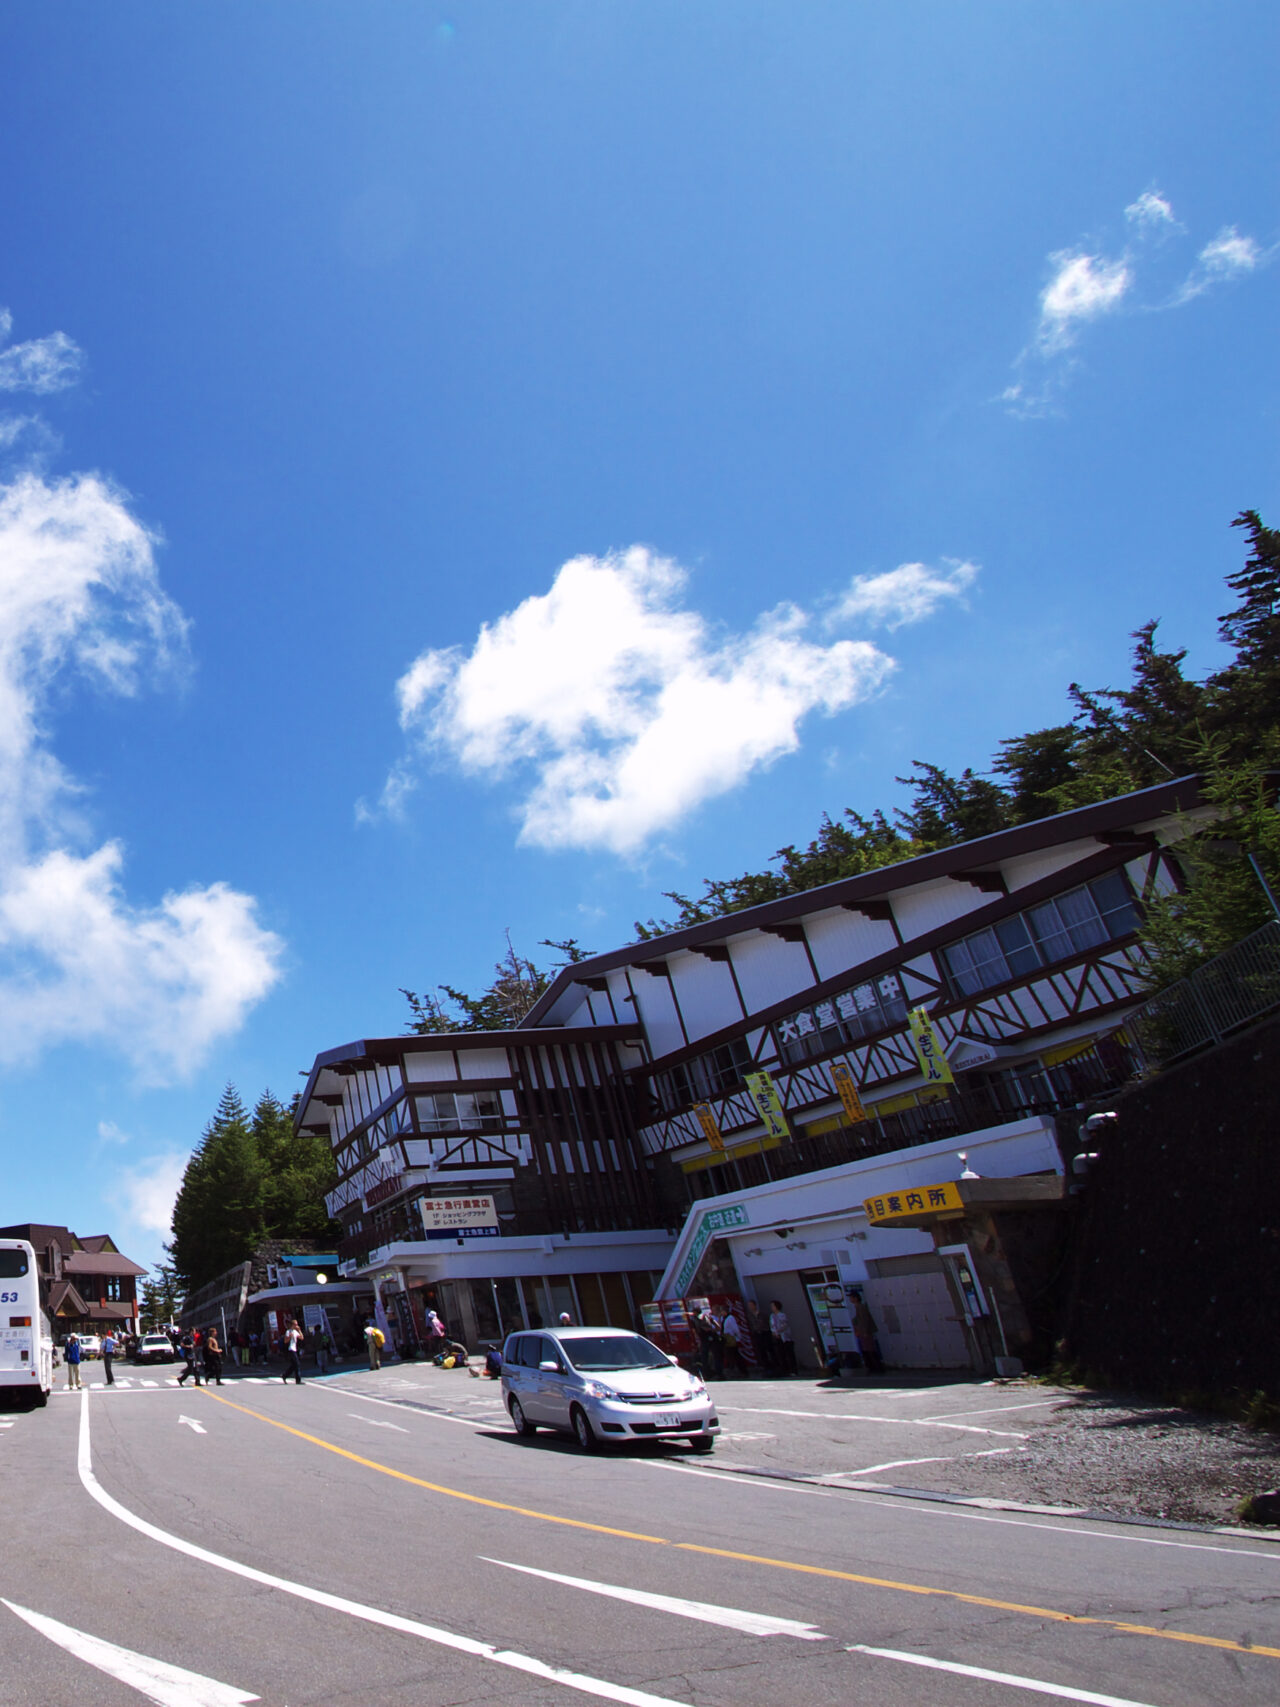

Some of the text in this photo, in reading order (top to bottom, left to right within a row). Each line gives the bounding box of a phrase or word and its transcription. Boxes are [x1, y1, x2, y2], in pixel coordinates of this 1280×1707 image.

[779, 975, 900, 1043] 大食堂営業中
[918, 1034, 941, 1080] 生ビール
[0, 1292, 19, 1303] 53
